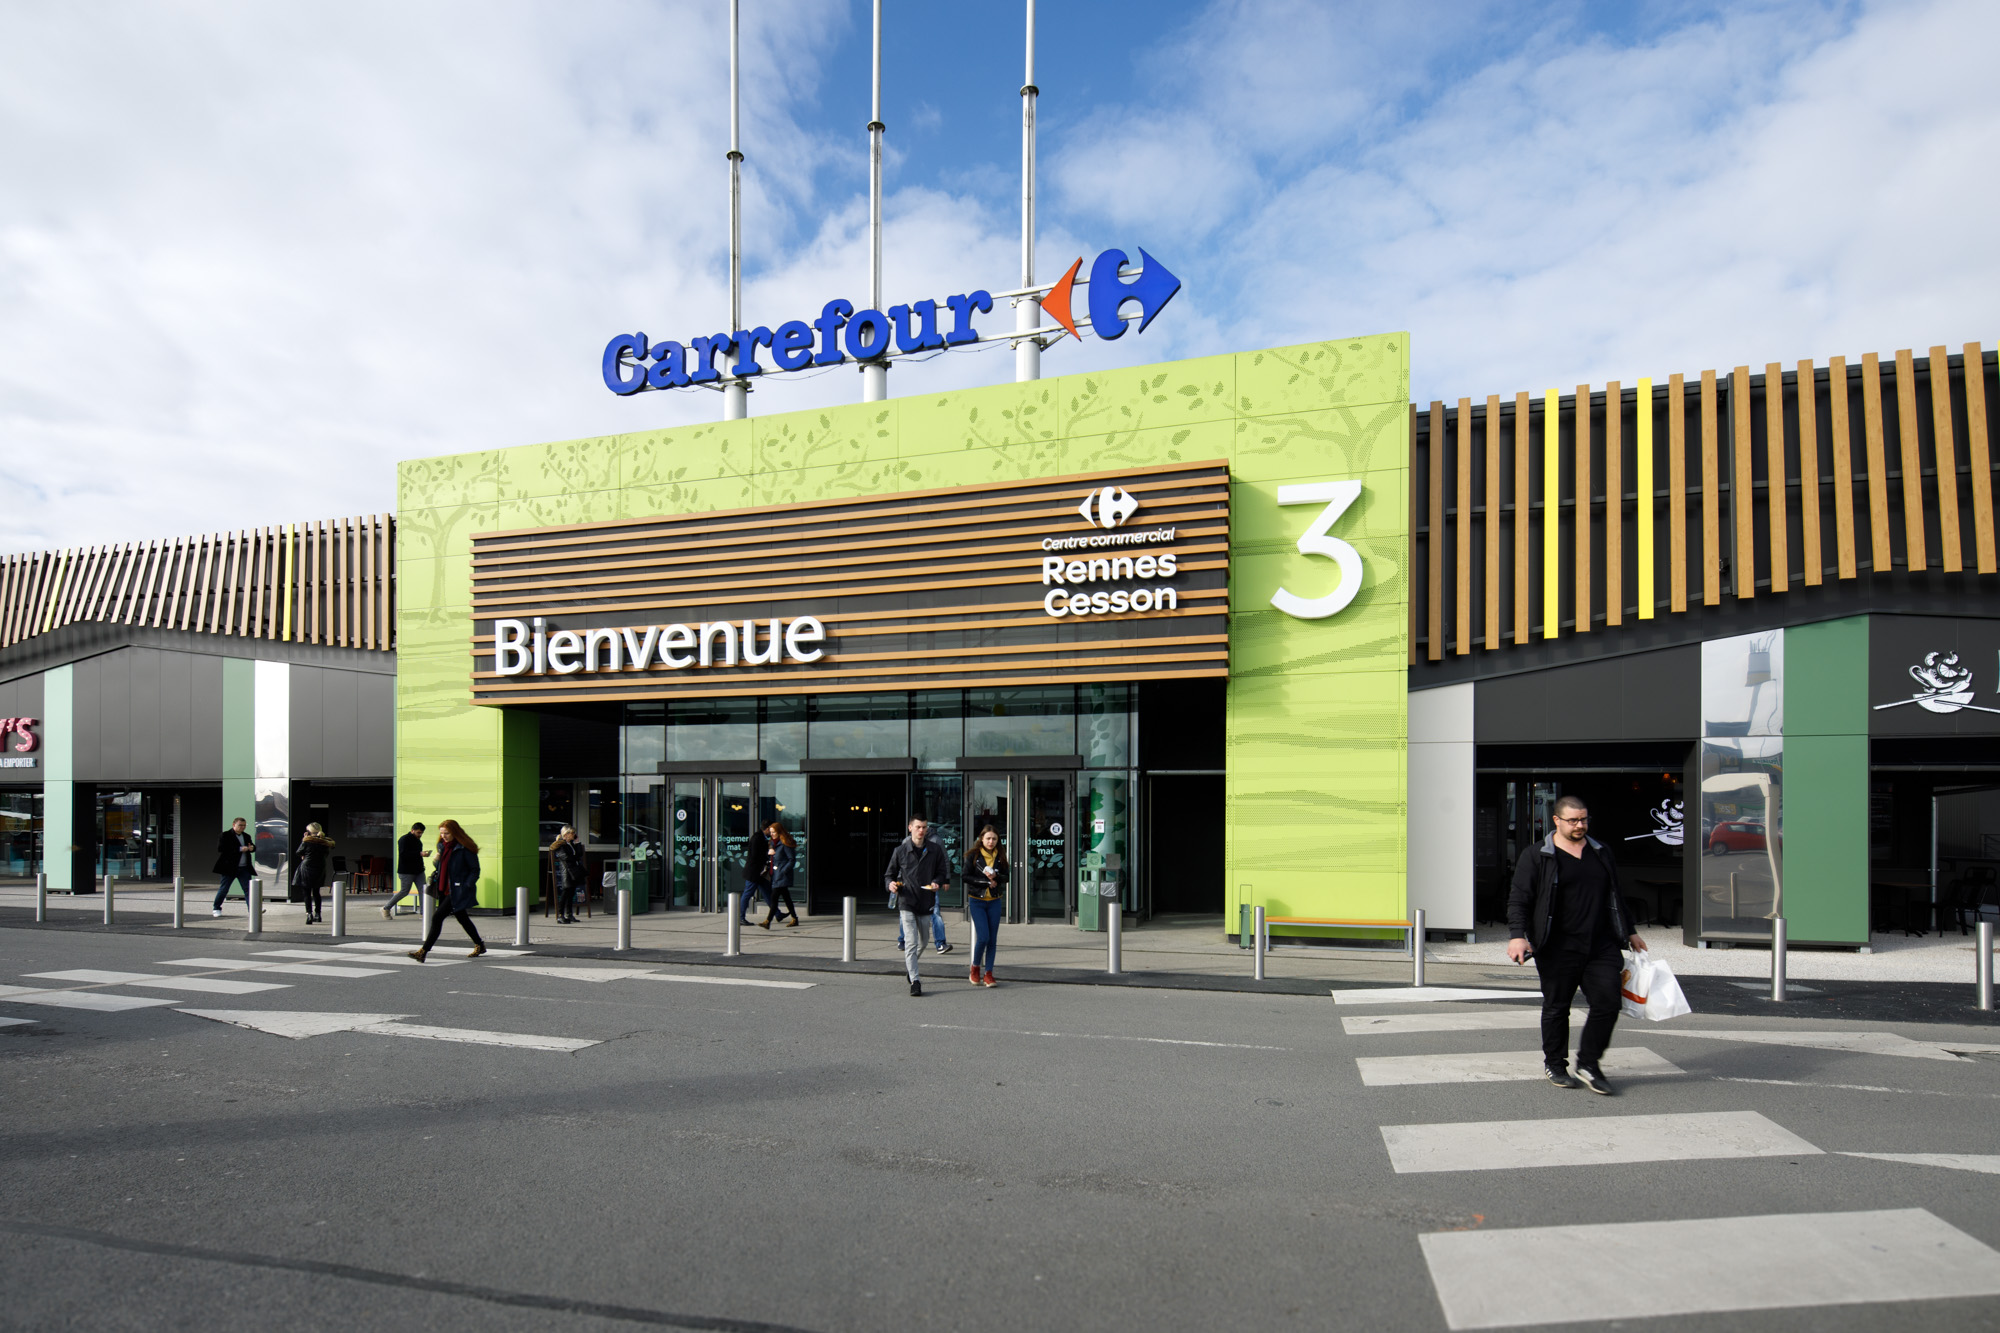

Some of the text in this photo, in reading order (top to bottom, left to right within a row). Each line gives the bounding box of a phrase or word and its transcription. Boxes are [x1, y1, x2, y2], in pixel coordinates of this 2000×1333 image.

[602, 290, 993, 396] Carrefour
[1042, 527, 1176, 551] Centre commercial
[1270, 479, 1363, 619] 3
[1042, 553, 1177, 586] Rennes
[1044, 587, 1177, 618] Cesson
[494, 616, 827, 676] Bienvenue
[4, 757, 35, 768] EMPORTER
[676, 834, 704, 844] bonjou
[1037, 847, 1055, 855] mat
